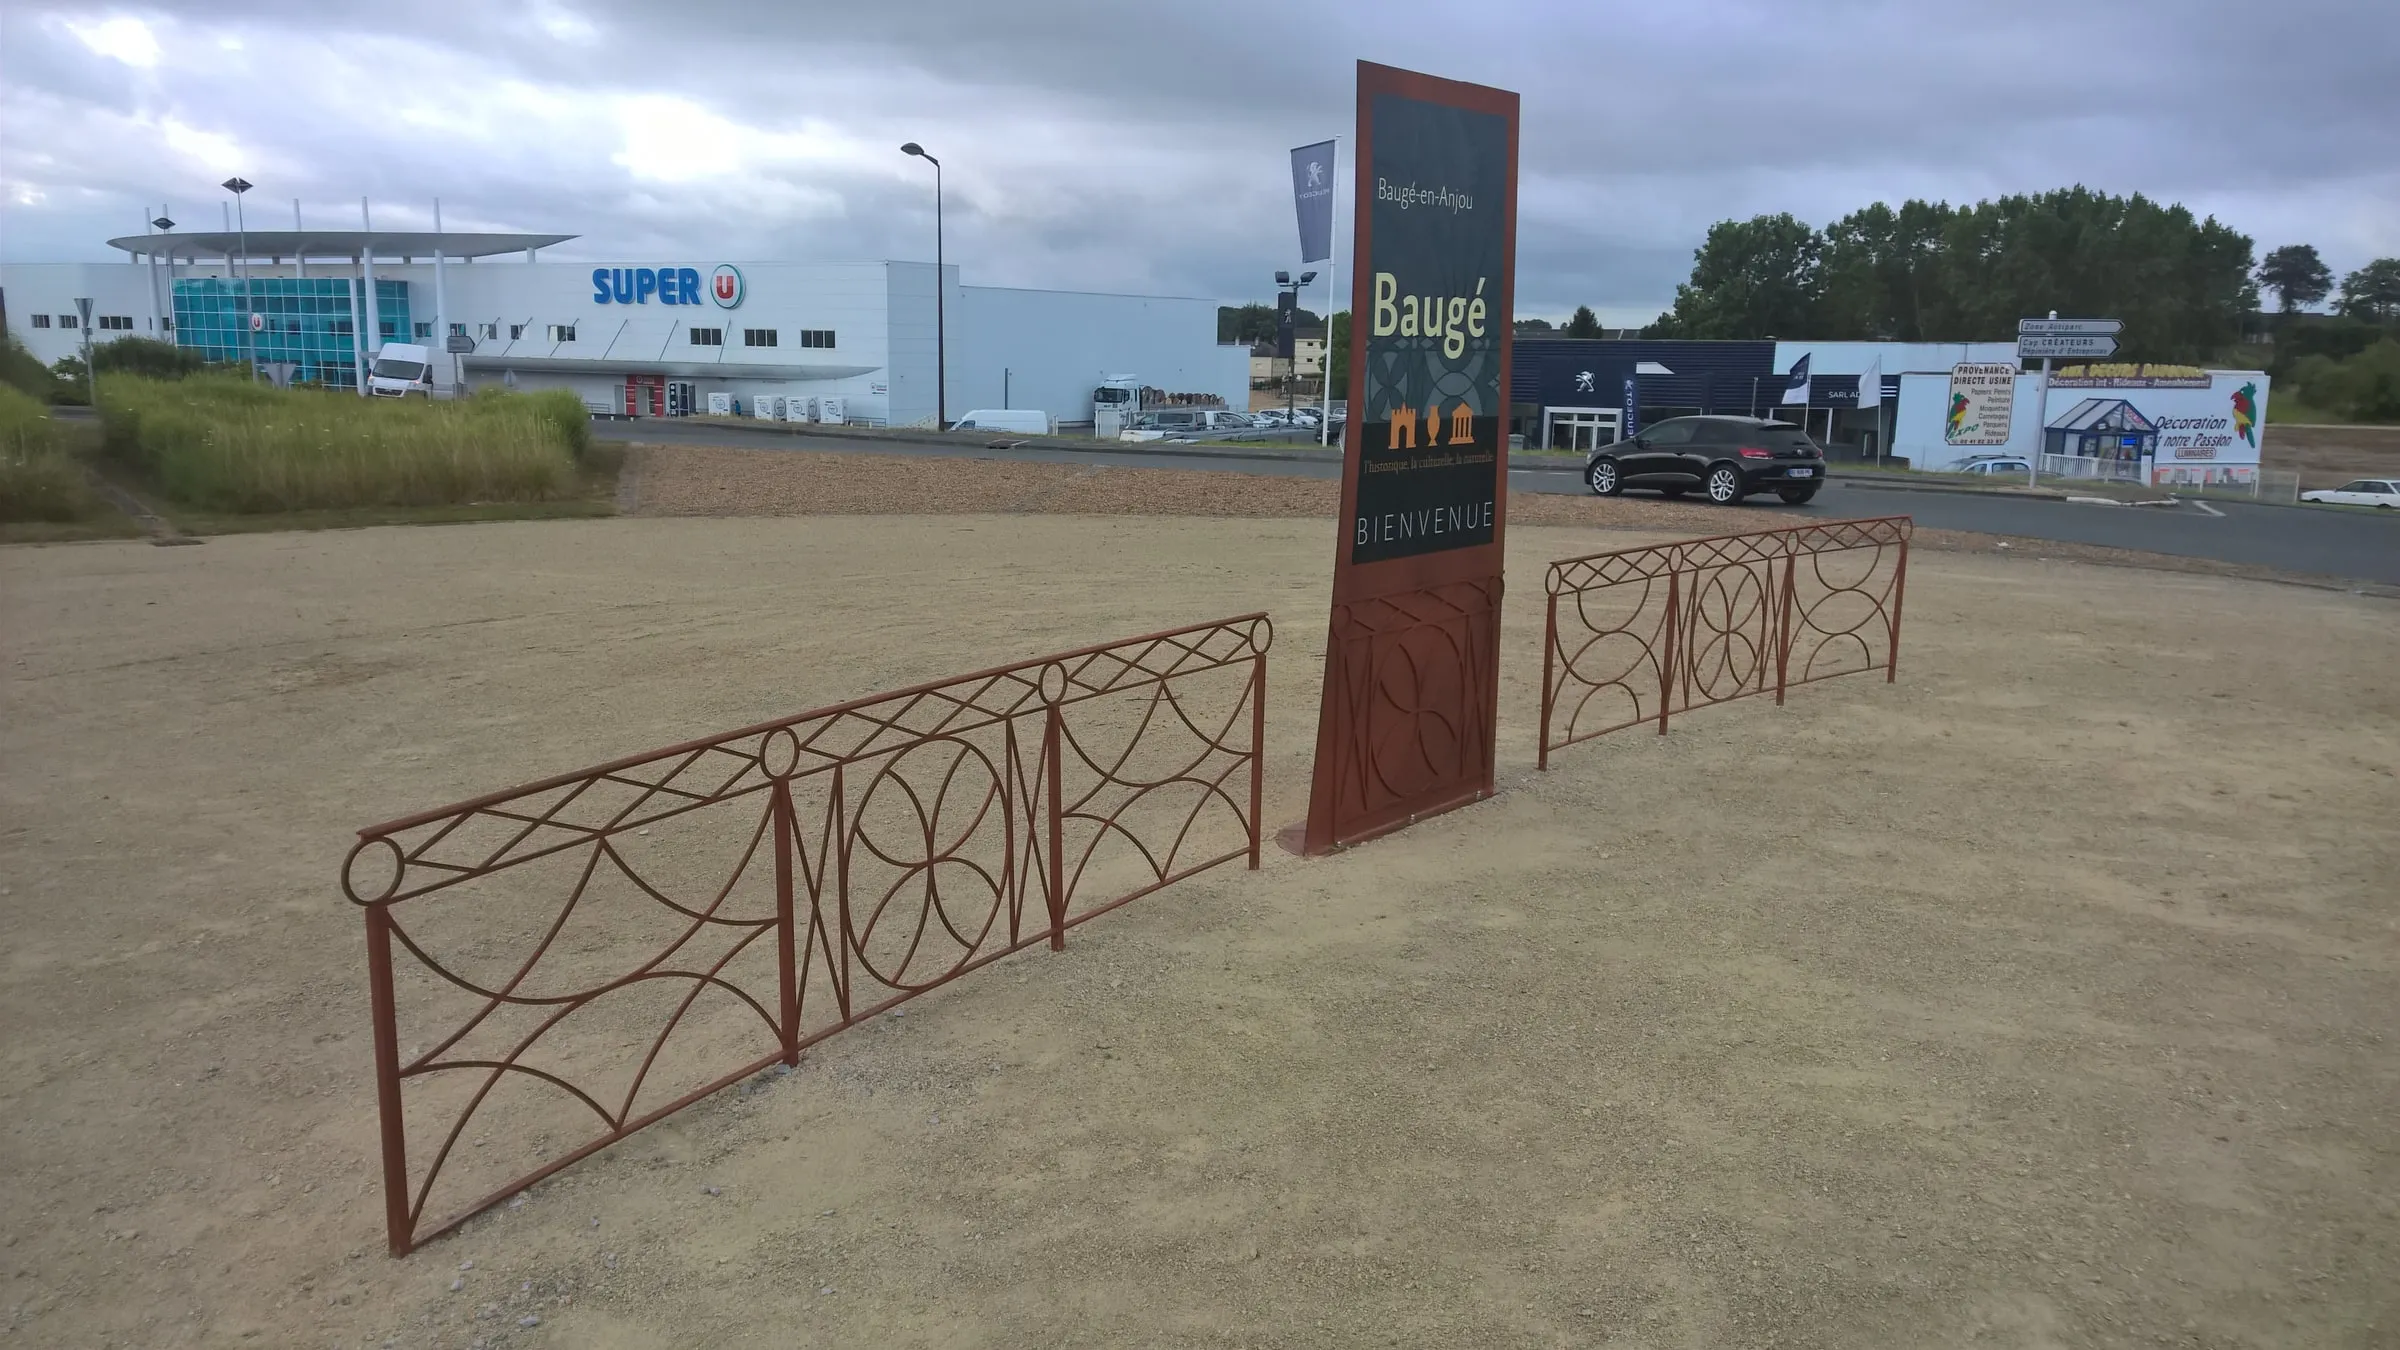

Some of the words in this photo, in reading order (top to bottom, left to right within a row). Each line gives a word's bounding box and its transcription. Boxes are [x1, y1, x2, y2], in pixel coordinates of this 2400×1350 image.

[1378, 177, 1473, 214] Baugé-en-Anjou
[592, 268, 703, 305] SUPER
[716, 275, 734, 299] U
[1374, 272, 1486, 360] Baugé
[2024, 322, 2044, 330] Zone
[2023, 339, 2039, 347] Cap
[2042, 338, 2094, 346] CRÉATEURS
[1958, 366, 2010, 374] PROVENANCE
[1954, 376, 1985, 385] DIRECTE
[1988, 376, 2012, 385] USINE
[2048, 377, 2093, 387] Décoration
[1828, 391, 1848, 399] SARL
[2155, 415, 2228, 430] Décoration
[2164, 434, 2189, 447] notre
[2193, 433, 2232, 447] Passion
[1357, 501, 1492, 545] BIENVENUE
